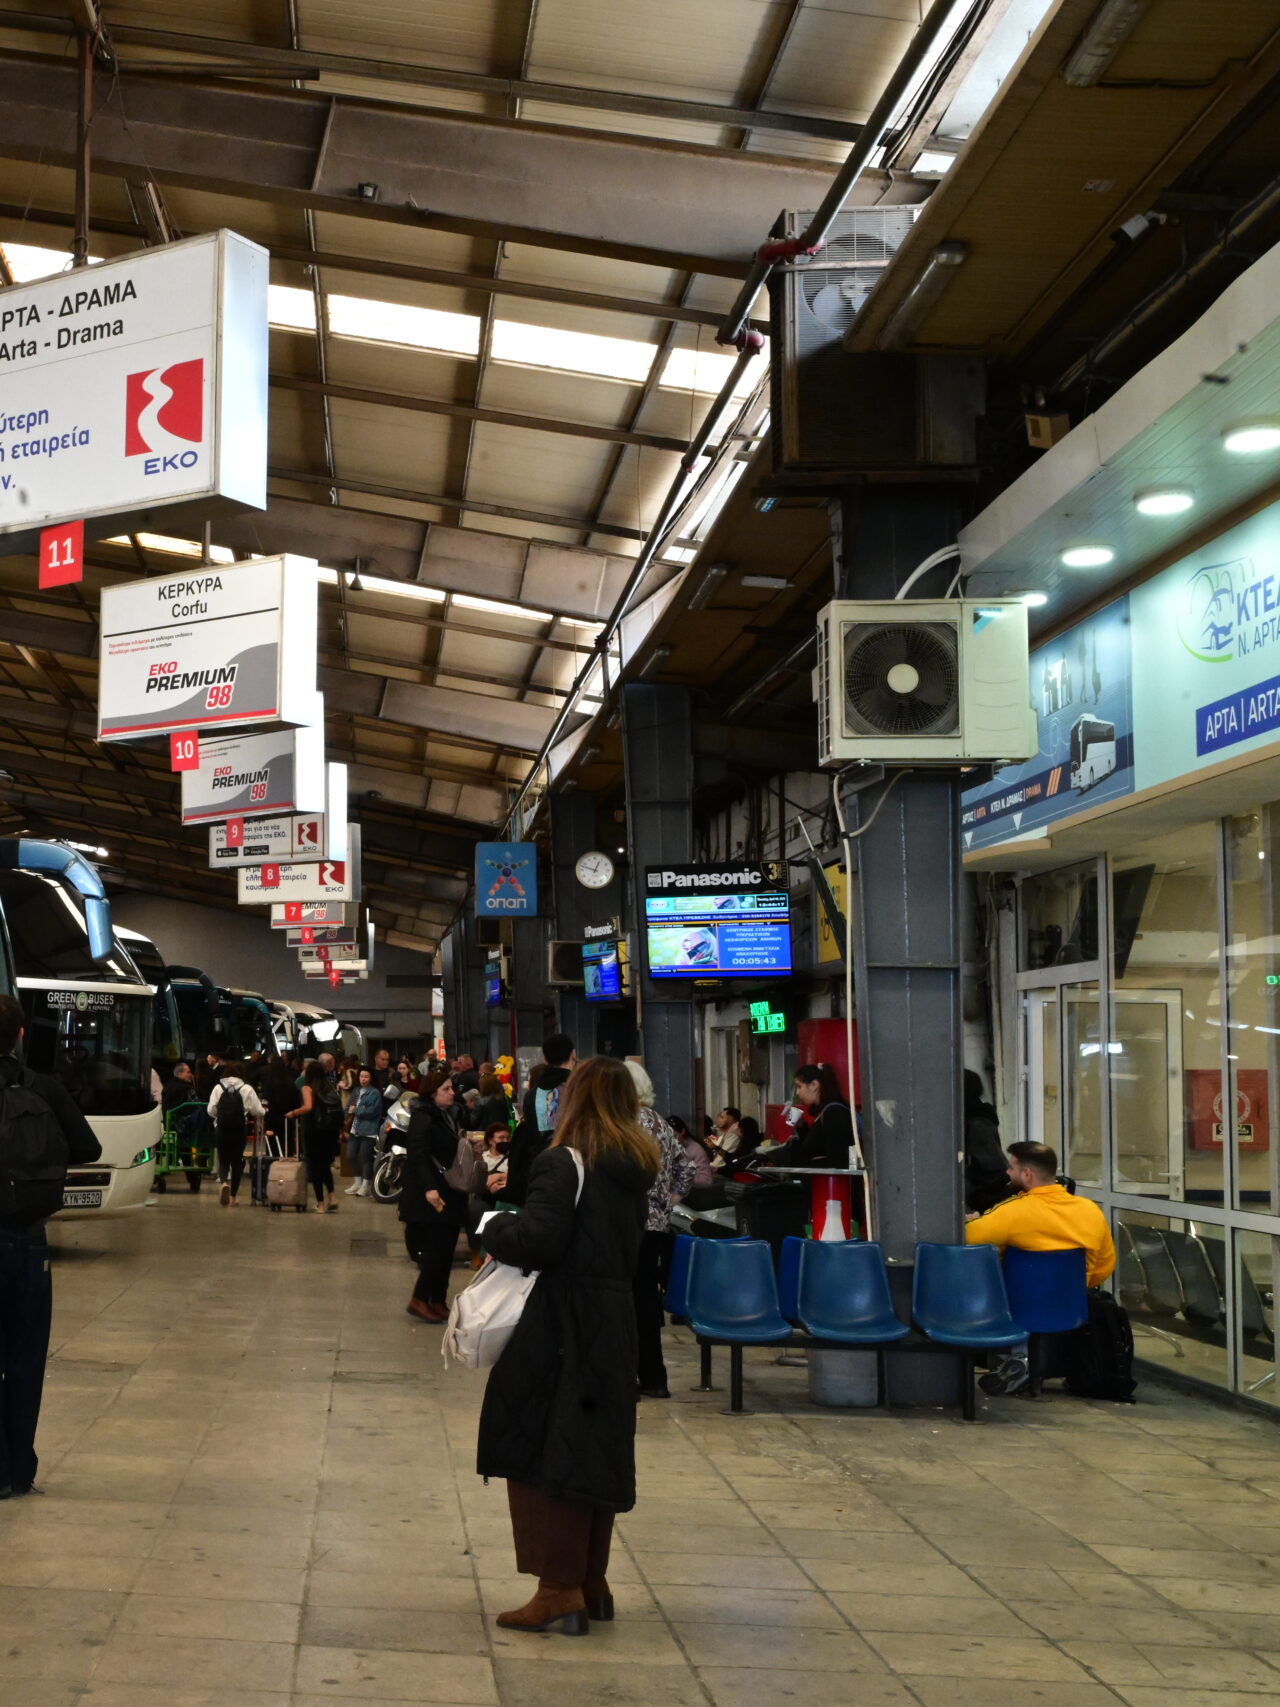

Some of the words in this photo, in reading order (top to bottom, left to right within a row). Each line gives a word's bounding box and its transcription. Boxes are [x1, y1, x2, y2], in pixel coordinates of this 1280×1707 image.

[58, 280, 137, 318] ΔΡΑΜΑ
[57, 319, 124, 349] Drama
[11, 426, 90, 457] εταιρεία
[144, 450, 198, 475] EKO
[48, 537, 75, 568] 11
[158, 576, 223, 601] ΚΕΡΚΥΡΑ
[172, 600, 207, 618] Corfu
[149, 661, 178, 676] EKO
[146, 666, 237, 693] PREMIUM
[207, 685, 232, 708] 98
[1205, 705, 1238, 742] ΑΡΤΑ
[175, 740, 194, 759] 10
[212, 770, 268, 790] PREMIUM
[214, 766, 232, 777] EKO
[251, 783, 267, 800] 98
[231, 825, 238, 838] 9
[267, 869, 274, 880] 8
[662, 868, 762, 888] Panasonic
[290, 907, 296, 916] 7
[302, 902, 327, 910] EMIUM
[315, 910, 326, 918] 98
[304, 931, 310, 939] 6
[732, 957, 777, 965] 00:05:43
[47, 992, 77, 1003] GREEN
[88, 994, 114, 1005] BUSES
